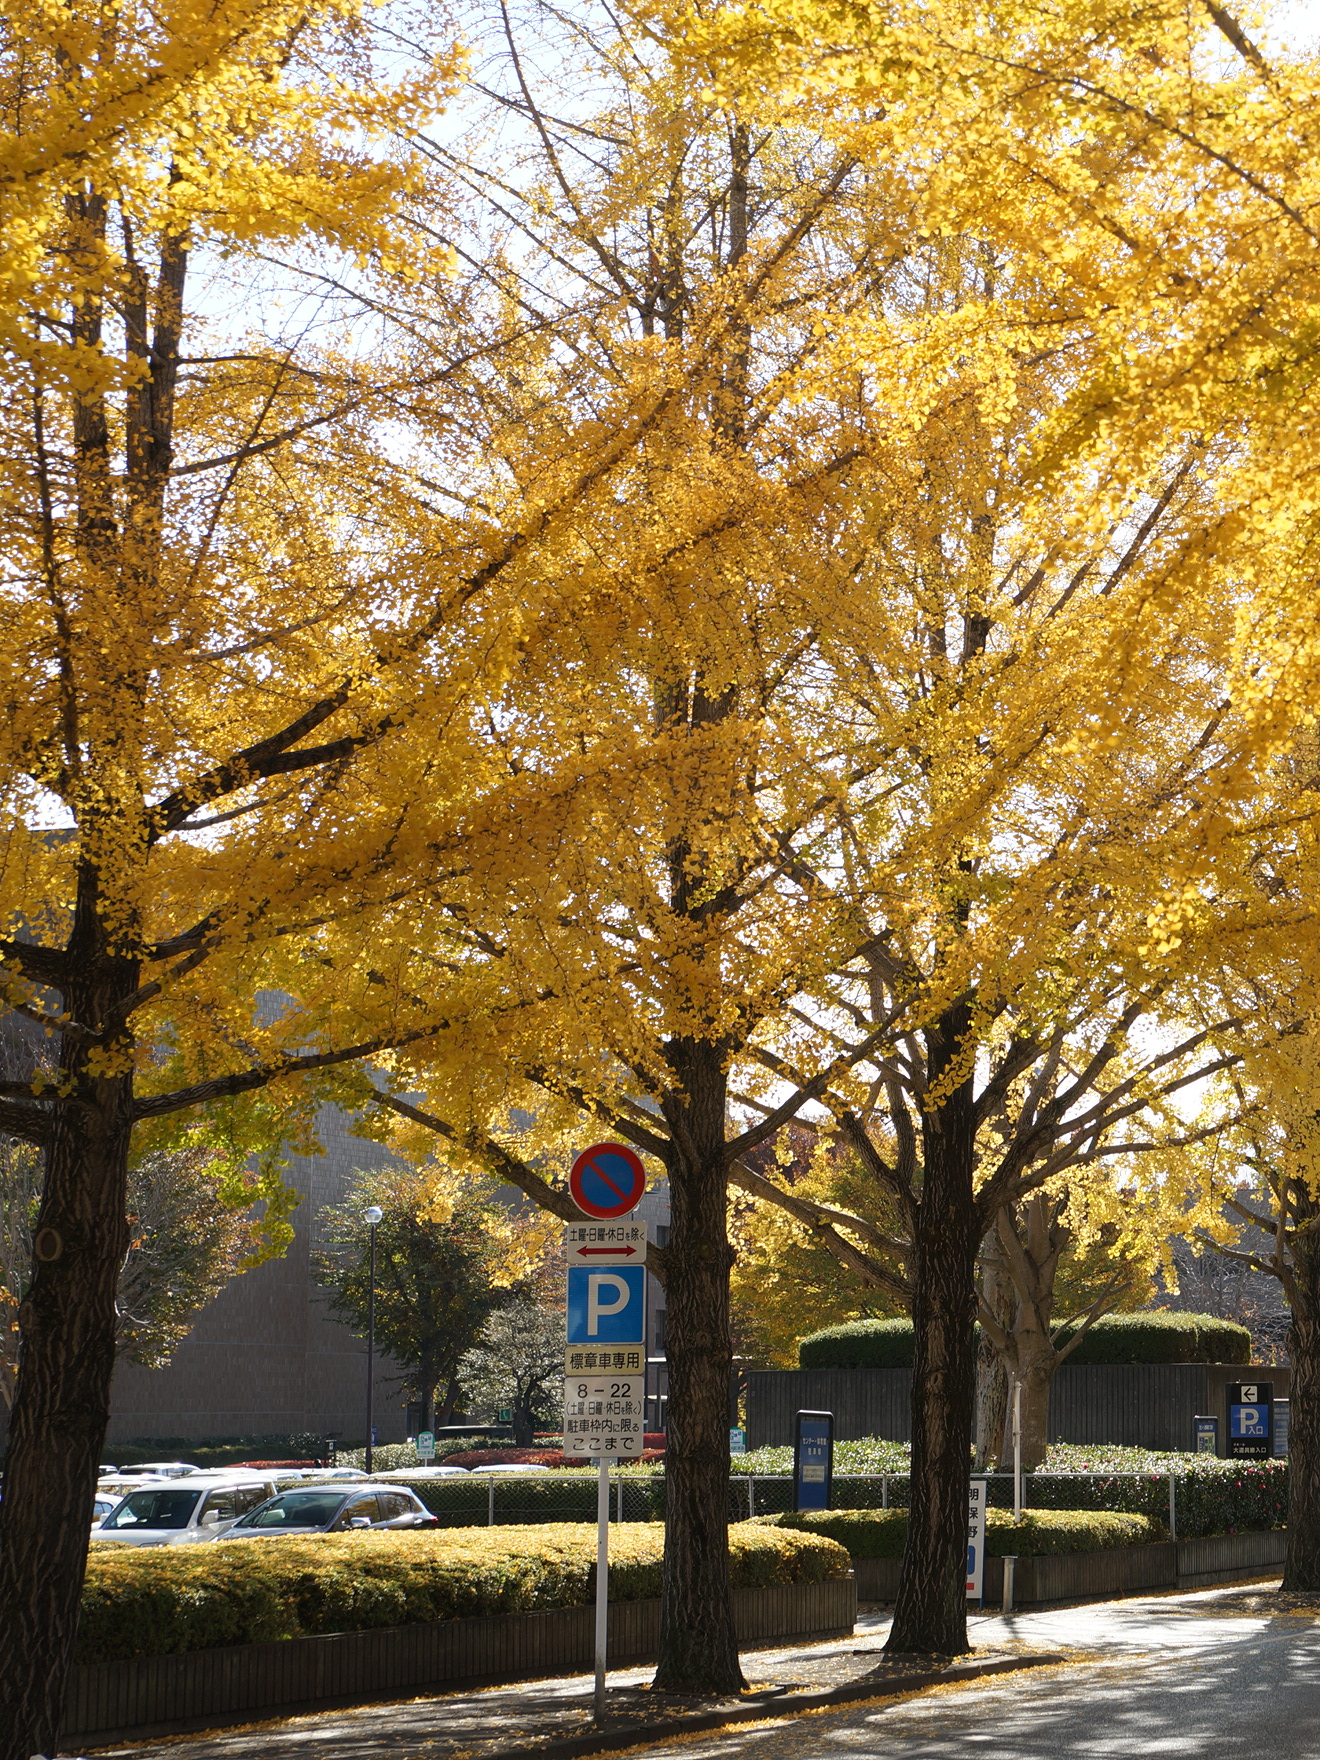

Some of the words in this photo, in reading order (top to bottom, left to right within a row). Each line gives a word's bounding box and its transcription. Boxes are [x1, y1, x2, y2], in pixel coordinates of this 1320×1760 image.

[570, 1227, 645, 1241] 土曜・日曜・休日を除く
[587, 1274, 630, 1336] P
[570, 1352, 640, 1369] 標章車専用
[567, 1419, 640, 1433] 駐車枠内に限る
[1240, 1408, 1259, 1434] P
[1248, 1426, 1263, 1434] 入口
[573, 1437, 634, 1451] ここまで
